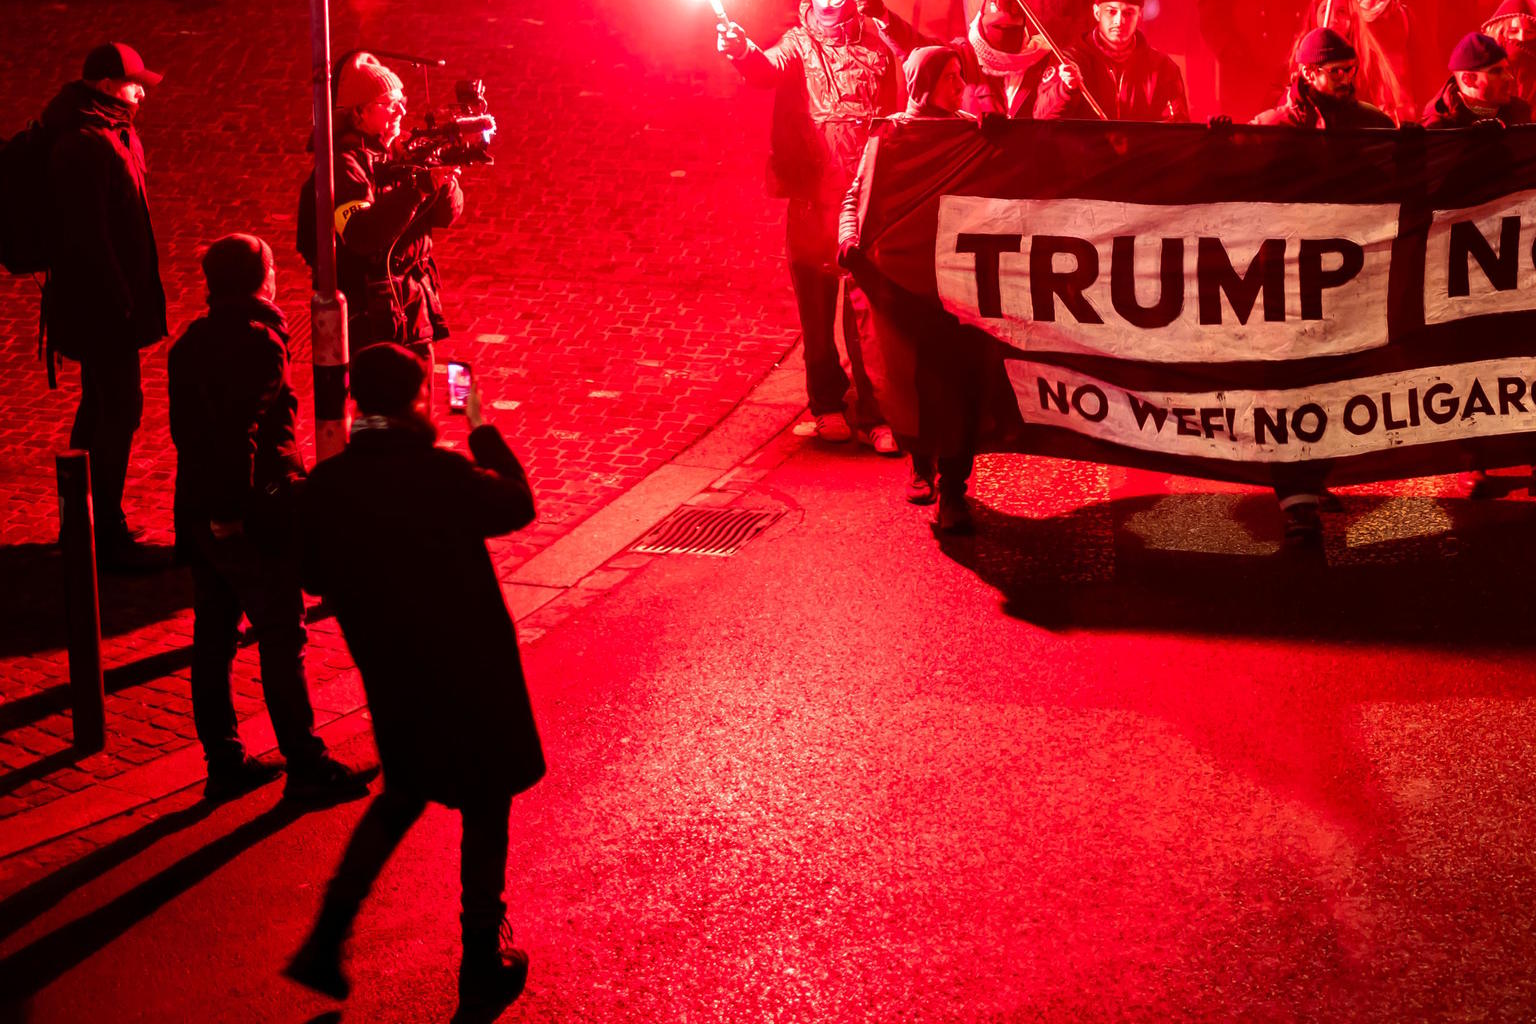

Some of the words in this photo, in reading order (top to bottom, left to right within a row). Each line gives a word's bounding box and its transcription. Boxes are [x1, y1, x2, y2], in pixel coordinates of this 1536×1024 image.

[956, 232, 1365, 330] TRUMP
[1036, 376, 1110, 423] NO
[1126, 390, 1239, 442] WEF!
[1253, 402, 1329, 444] NO
